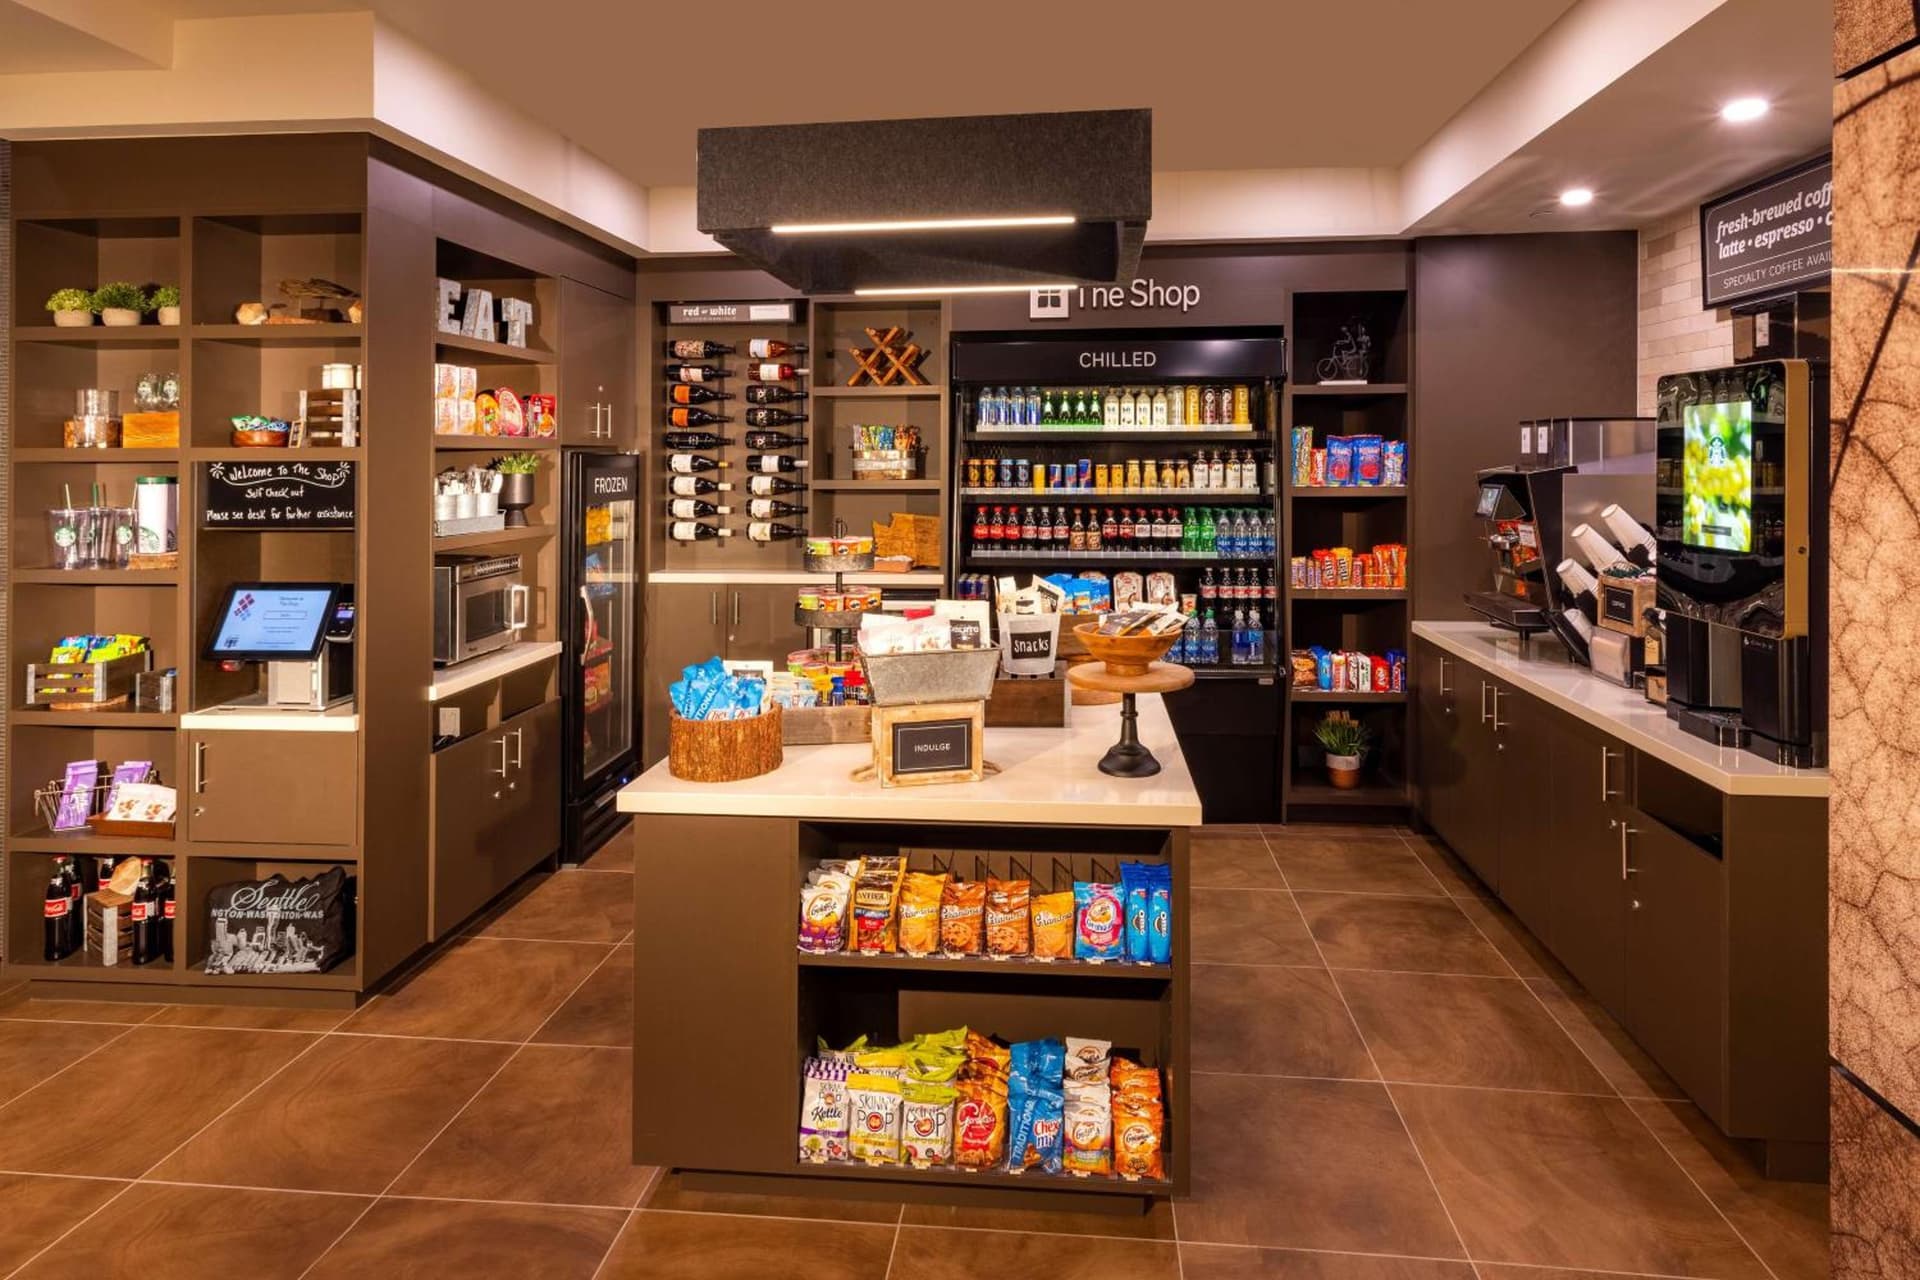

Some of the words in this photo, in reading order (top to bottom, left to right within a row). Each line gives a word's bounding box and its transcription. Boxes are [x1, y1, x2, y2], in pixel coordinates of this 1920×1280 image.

[1715, 192, 1802, 243] fresh-brewed
[1718, 240, 1746, 259] latte
[1754, 217, 1814, 248] espresso
[1723, 269, 1767, 289] SPECIALTY
[1768, 258, 1804, 277] COFFEE
[1130, 278, 1200, 312] Shop
[437, 277, 533, 348] EAT
[683, 306, 699, 316] red
[710, 305, 737, 316] white
[1079, 351, 1157, 368] CHILLED
[229, 464, 272, 481] Welcome
[292, 463, 310, 475] The
[314, 467, 340, 486] Shop
[245, 487, 263, 498] Self
[594, 476, 628, 494] FROZEN
[206, 509, 229, 522] Please
[232, 511, 243, 520] see
[248, 508, 266, 519] desk
[271, 507, 281, 519] for
[286, 507, 311, 520] further
[317, 506, 353, 519] assistance
[1014, 638, 1049, 653] snacks
[914, 743, 951, 753] INDULGE
[226, 879, 320, 912] Seattle
[1033, 1119, 1060, 1136] Chex
